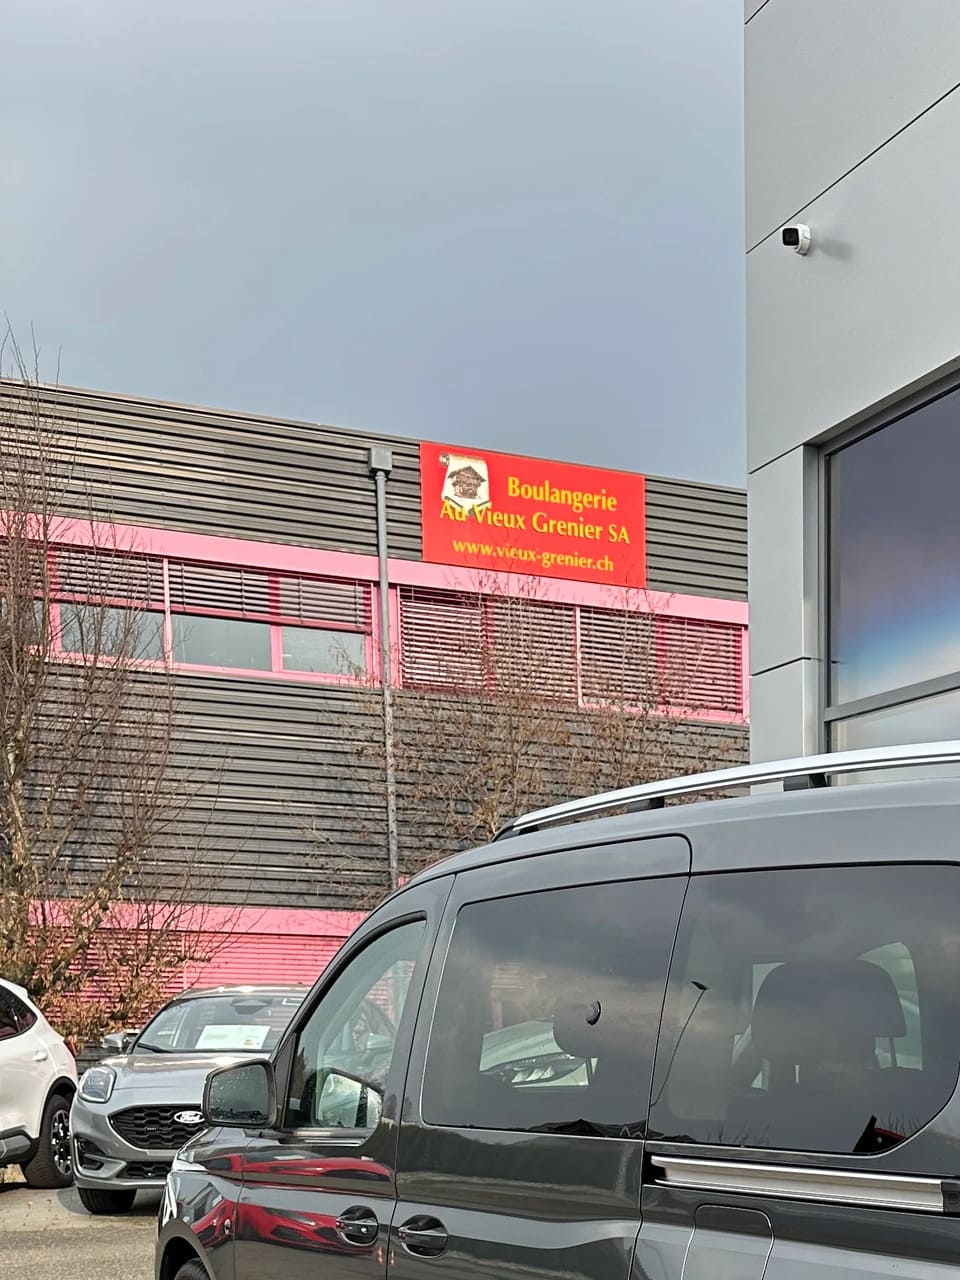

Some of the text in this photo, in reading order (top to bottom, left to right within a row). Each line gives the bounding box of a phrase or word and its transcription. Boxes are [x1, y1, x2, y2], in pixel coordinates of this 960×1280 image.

[507, 476, 618, 513] Boulangerie
[440, 499, 631, 544] Au Vieux Grenier SA
[452, 538, 614, 572] www.vieux-grenier.ch
